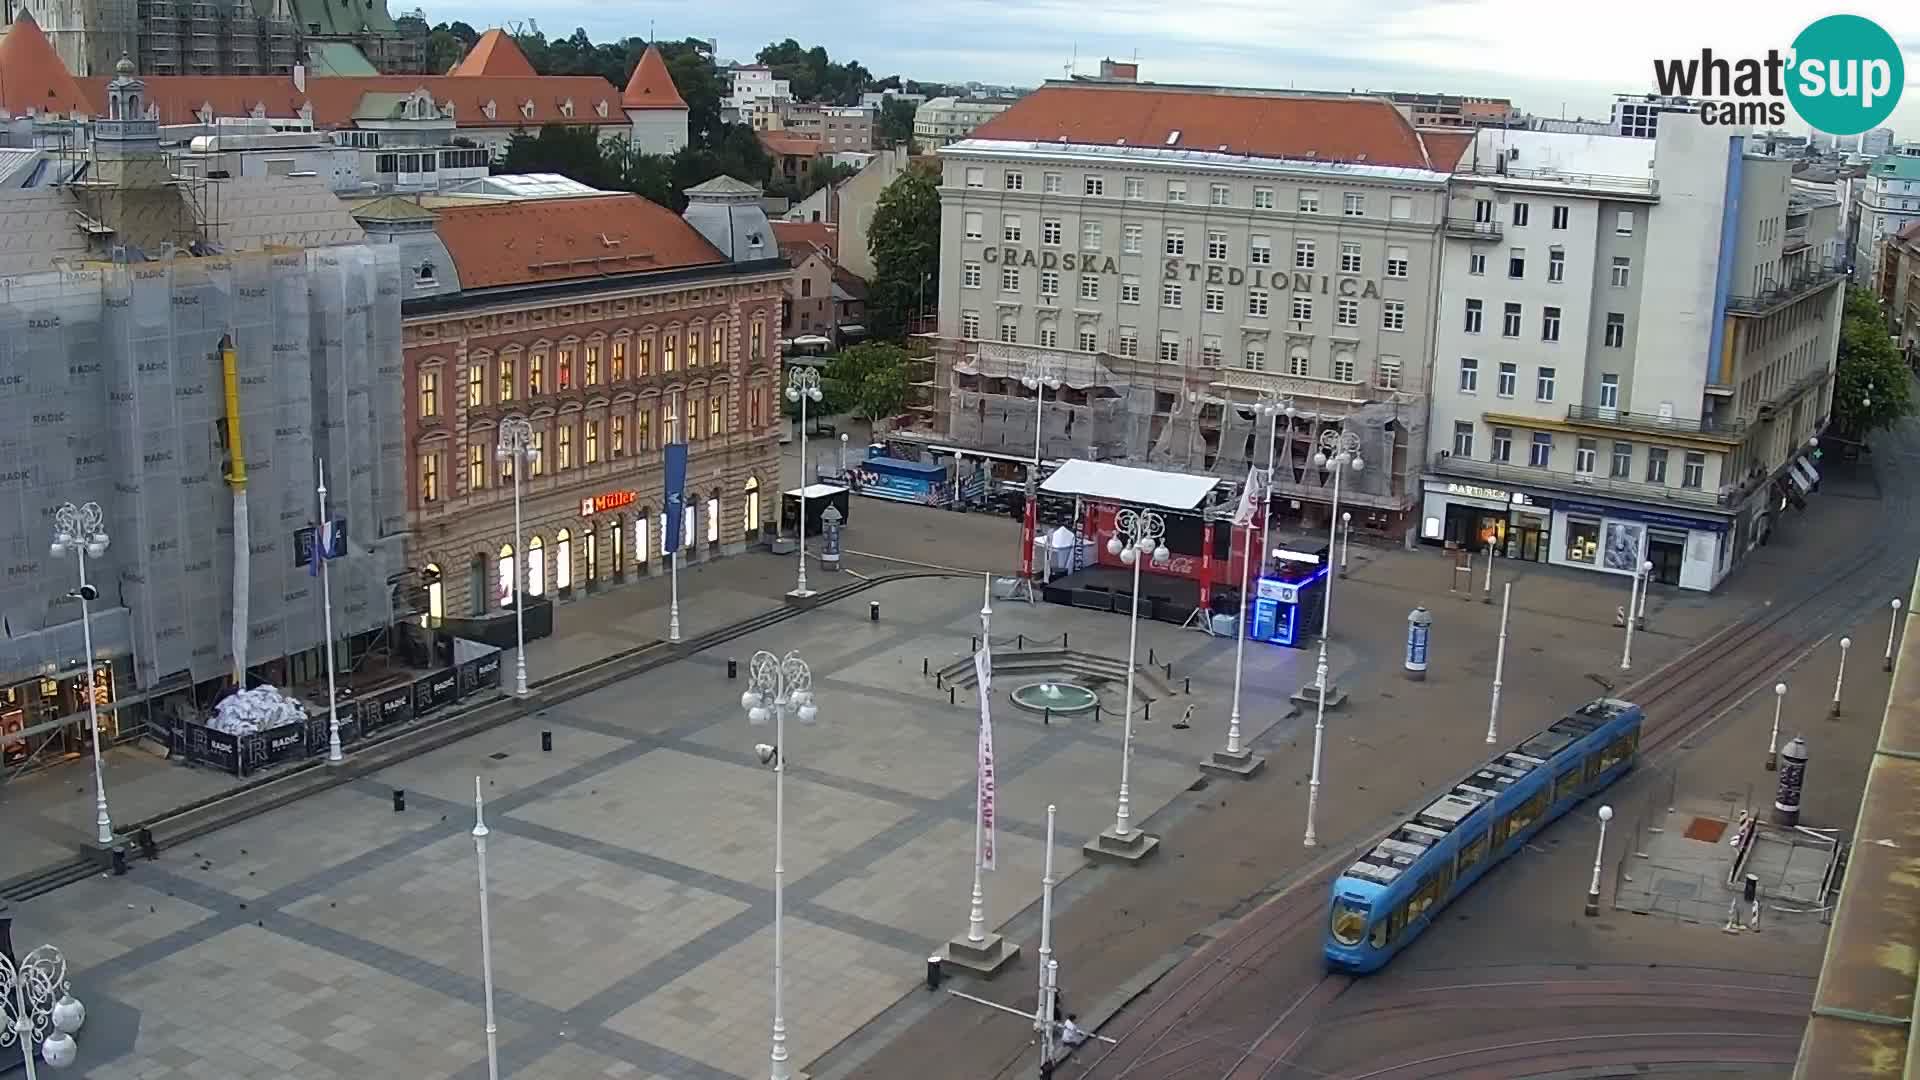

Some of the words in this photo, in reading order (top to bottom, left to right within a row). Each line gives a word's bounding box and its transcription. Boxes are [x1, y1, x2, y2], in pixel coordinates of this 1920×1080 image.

[983, 246, 1119, 275] GRADSKA
[1164, 258, 1380, 299] ŠTEDIONICA
[595, 491, 637, 511] Müller
